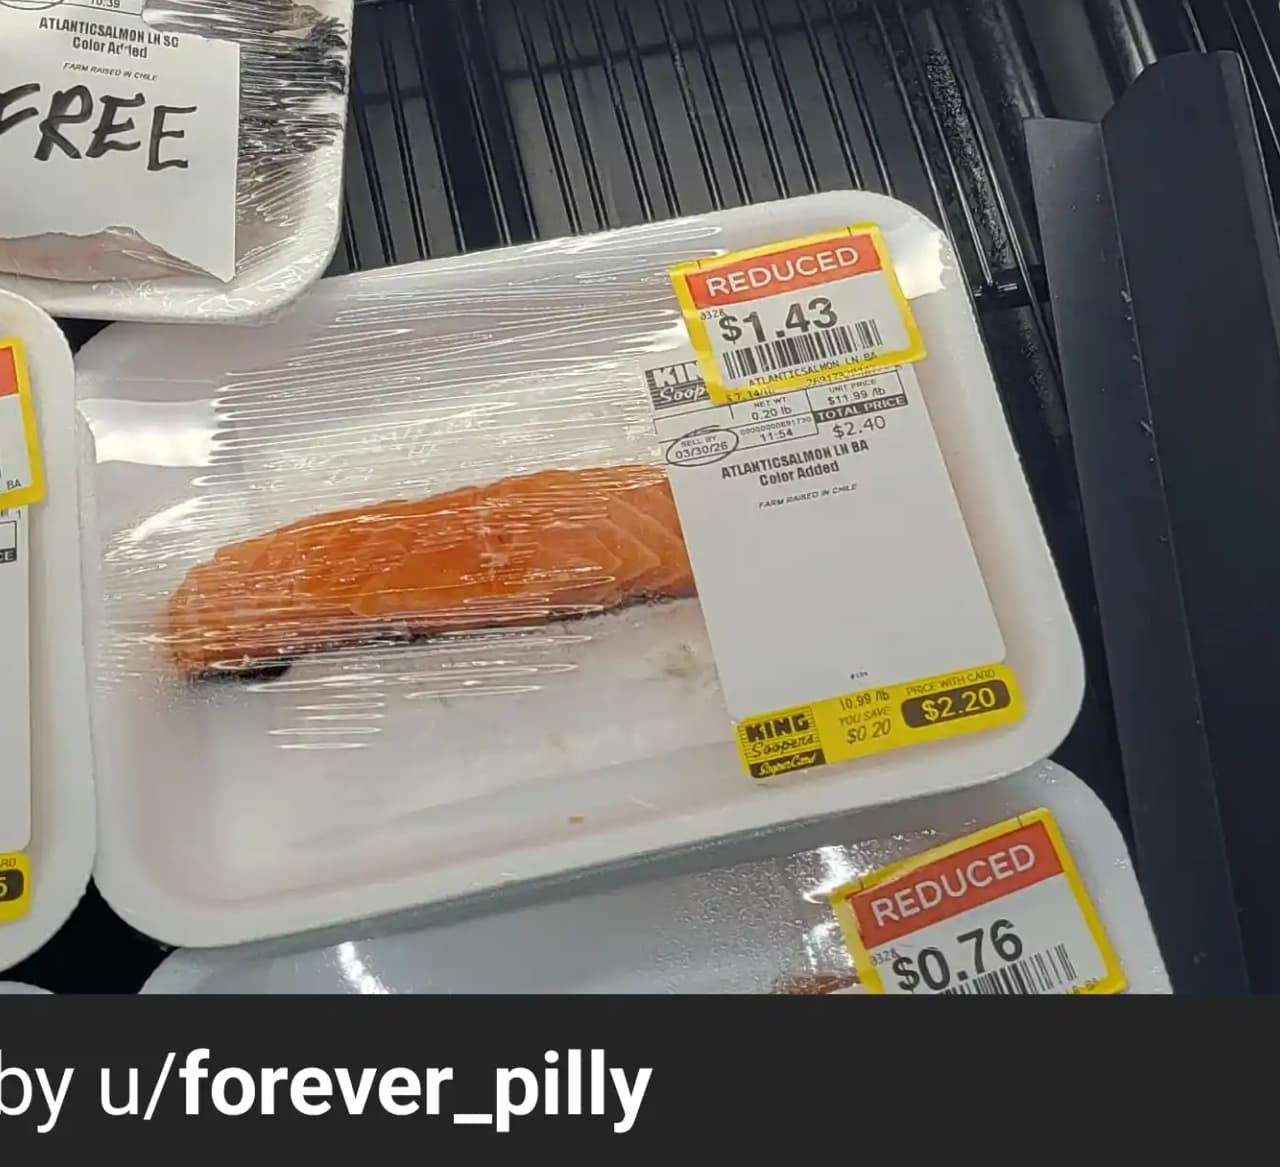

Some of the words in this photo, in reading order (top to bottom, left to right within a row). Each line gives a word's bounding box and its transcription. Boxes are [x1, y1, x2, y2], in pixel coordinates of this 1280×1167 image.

[39, 17, 144, 43] ATLANTICSALMON
[706, 247, 858, 297] REDUCED
[719, 297, 838, 345] $1.43
[749, 361, 840, 387] ATLANTICSALMON
[775, 397, 787, 405] WT
[820, 406, 860, 420] TOTAL
[865, 397, 906, 411] PRICE
[828, 392, 868, 405] $11.99
[751, 410, 778, 420] 0.20
[780, 406, 792, 415] lb
[760, 429, 793, 442] 11:54
[833, 415, 886, 439] $2.40
[675, 442, 728, 459] 03/30/26
[721, 447, 832, 479] ATLANTICSALMON
[853, 440, 869, 452] BA
[7, 479, 21, 489] BA
[759, 470, 794, 486] Color
[797, 461, 840, 479] Added
[906, 684, 937, 697] PRICE
[941, 677, 965, 690] WITH
[968, 669, 996, 682] CARD
[839, 714, 861, 727] YOU
[864, 707, 892, 721] SAVE
[921, 688, 995, 722] $2.20
[747, 714, 810, 742] KING
[871, 844, 1036, 927] REDUCED
[892, 919, 1023, 993] $0.76
